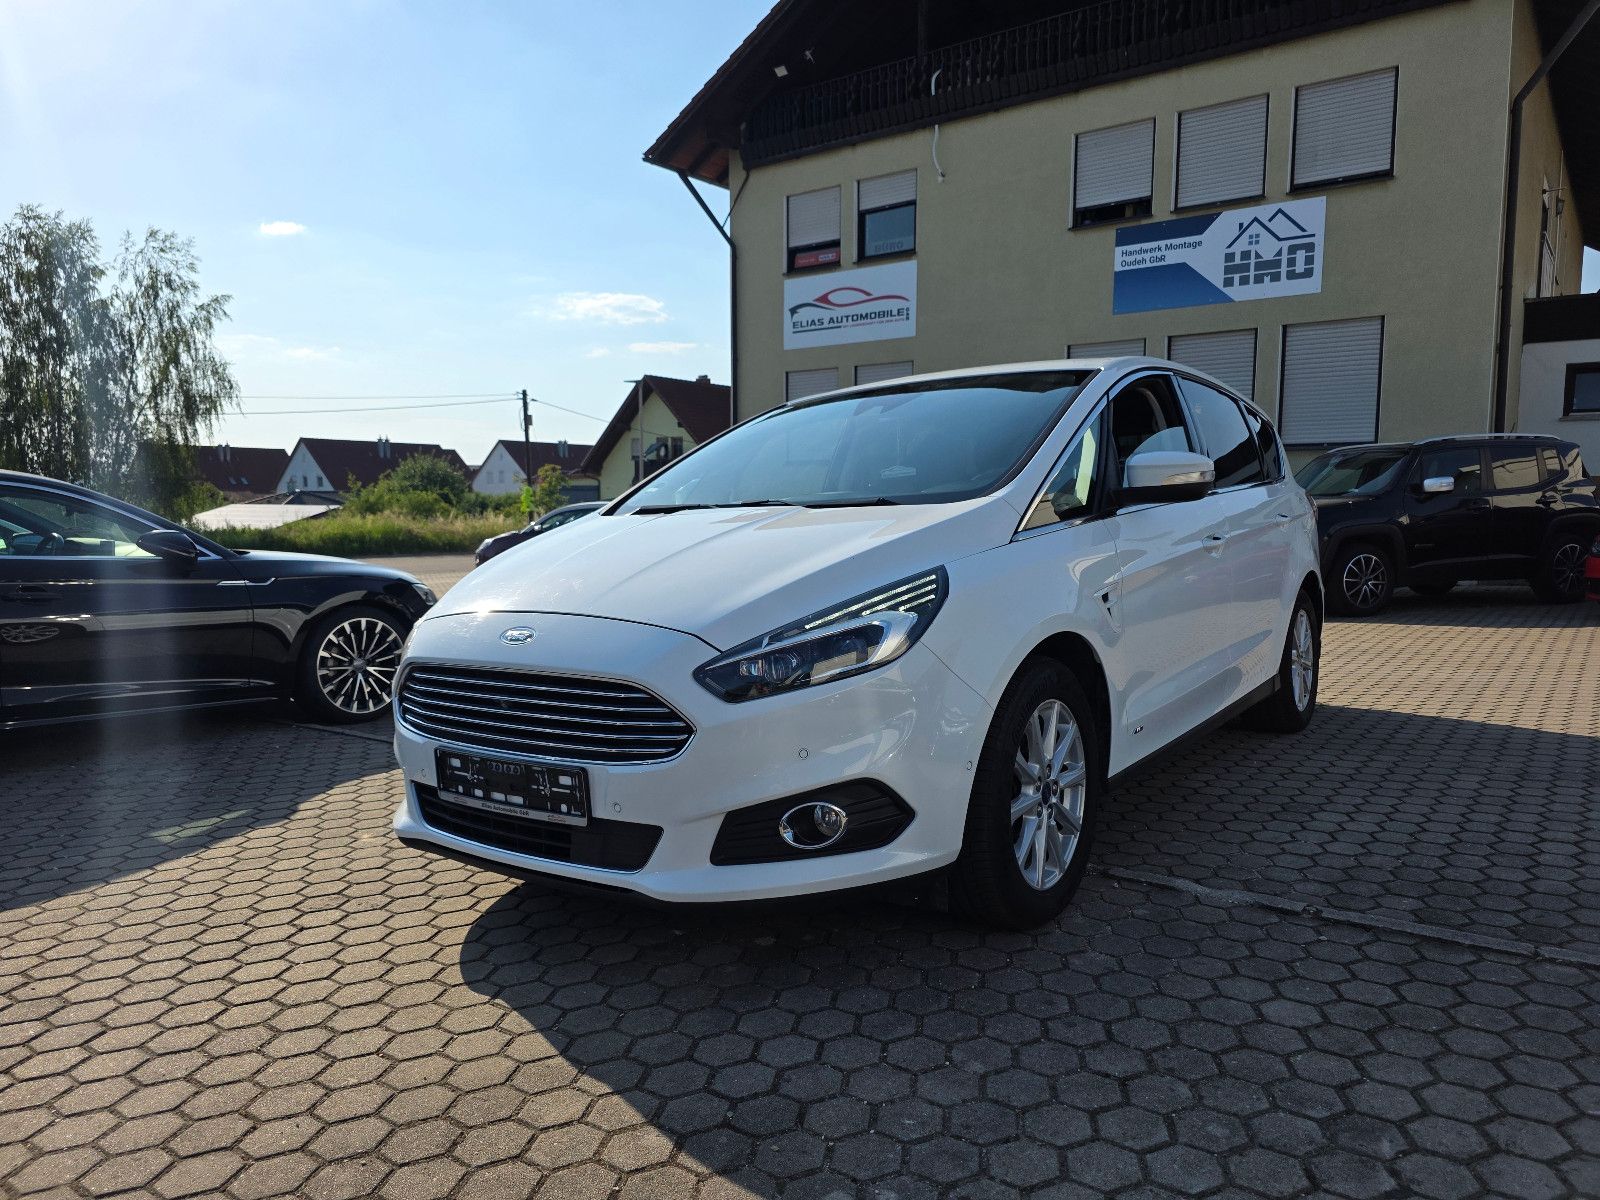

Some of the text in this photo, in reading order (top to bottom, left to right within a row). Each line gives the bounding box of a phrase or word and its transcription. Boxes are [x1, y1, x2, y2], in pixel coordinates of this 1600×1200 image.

[1121, 240, 1203, 257] Handwerk Montage
[1121, 254, 1166, 268] Oudeh GbR
[1222, 241, 1316, 288] HMO
[792, 318, 824, 330] ELIAS
[828, 307, 905, 325] AUTOMOBILE
